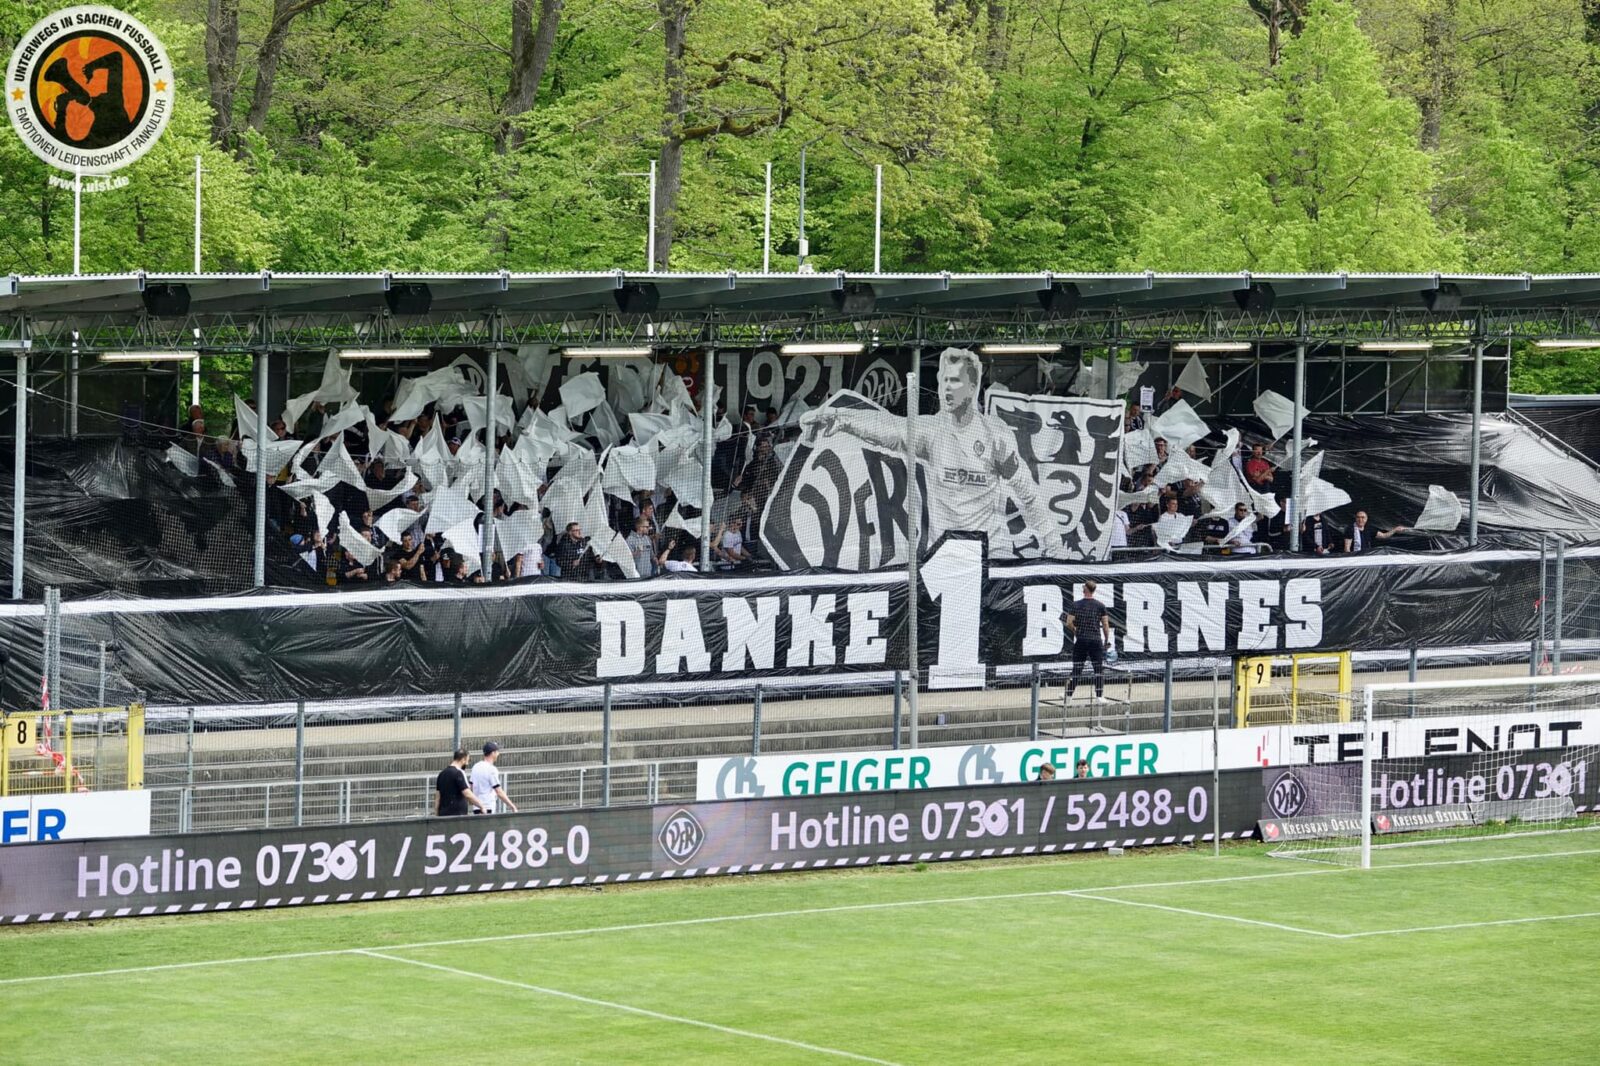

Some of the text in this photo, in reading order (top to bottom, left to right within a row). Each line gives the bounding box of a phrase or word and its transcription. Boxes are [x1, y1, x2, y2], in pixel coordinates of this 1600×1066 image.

[719, 351, 844, 424] 1921
[595, 591, 890, 678] DANKE
[919, 539, 986, 689] 1
[1256, 663, 1265, 684] 9
[17, 720, 27, 744] 8
[782, 756, 931, 796] GEIGER
[1020, 743, 1159, 782] GEIGER
[1371, 767, 1487, 809] Hotline
[2, 809, 67, 844] ER
[771, 805, 909, 850] Hotline
[1039, 796, 1056, 833] /
[1066, 786, 1208, 832] 52488-0
[1281, 818, 1363, 835] KREISBAU OSTAL
[1391, 813, 1434, 828] KREISBAU
[77, 848, 242, 897] Hotline
[393, 837, 412, 877] /
[424, 825, 590, 875] 52488-0
